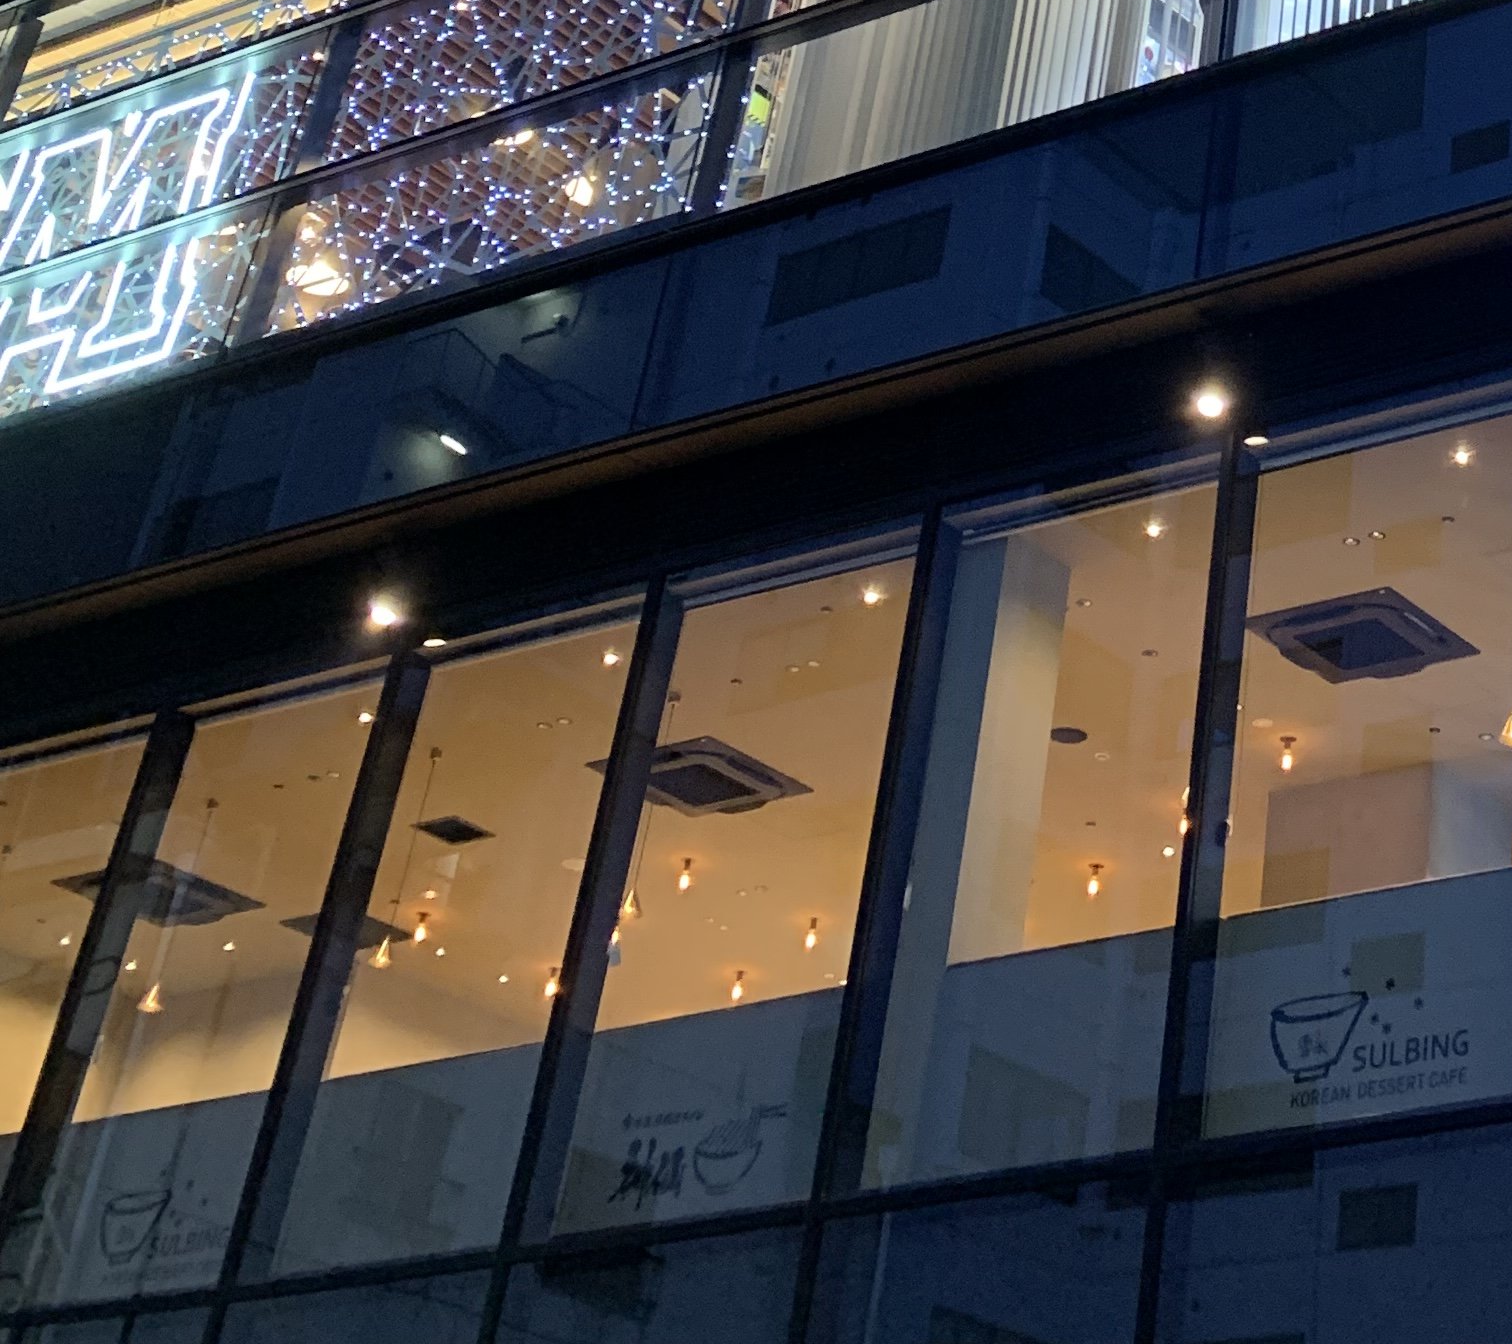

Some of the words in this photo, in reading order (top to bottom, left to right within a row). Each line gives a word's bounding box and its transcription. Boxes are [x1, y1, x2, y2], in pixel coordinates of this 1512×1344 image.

[1351, 1028, 1469, 1073] SULBING
[1290, 1084, 1351, 1108] KOREAN
[1357, 1072, 1426, 1099] DESSERT
